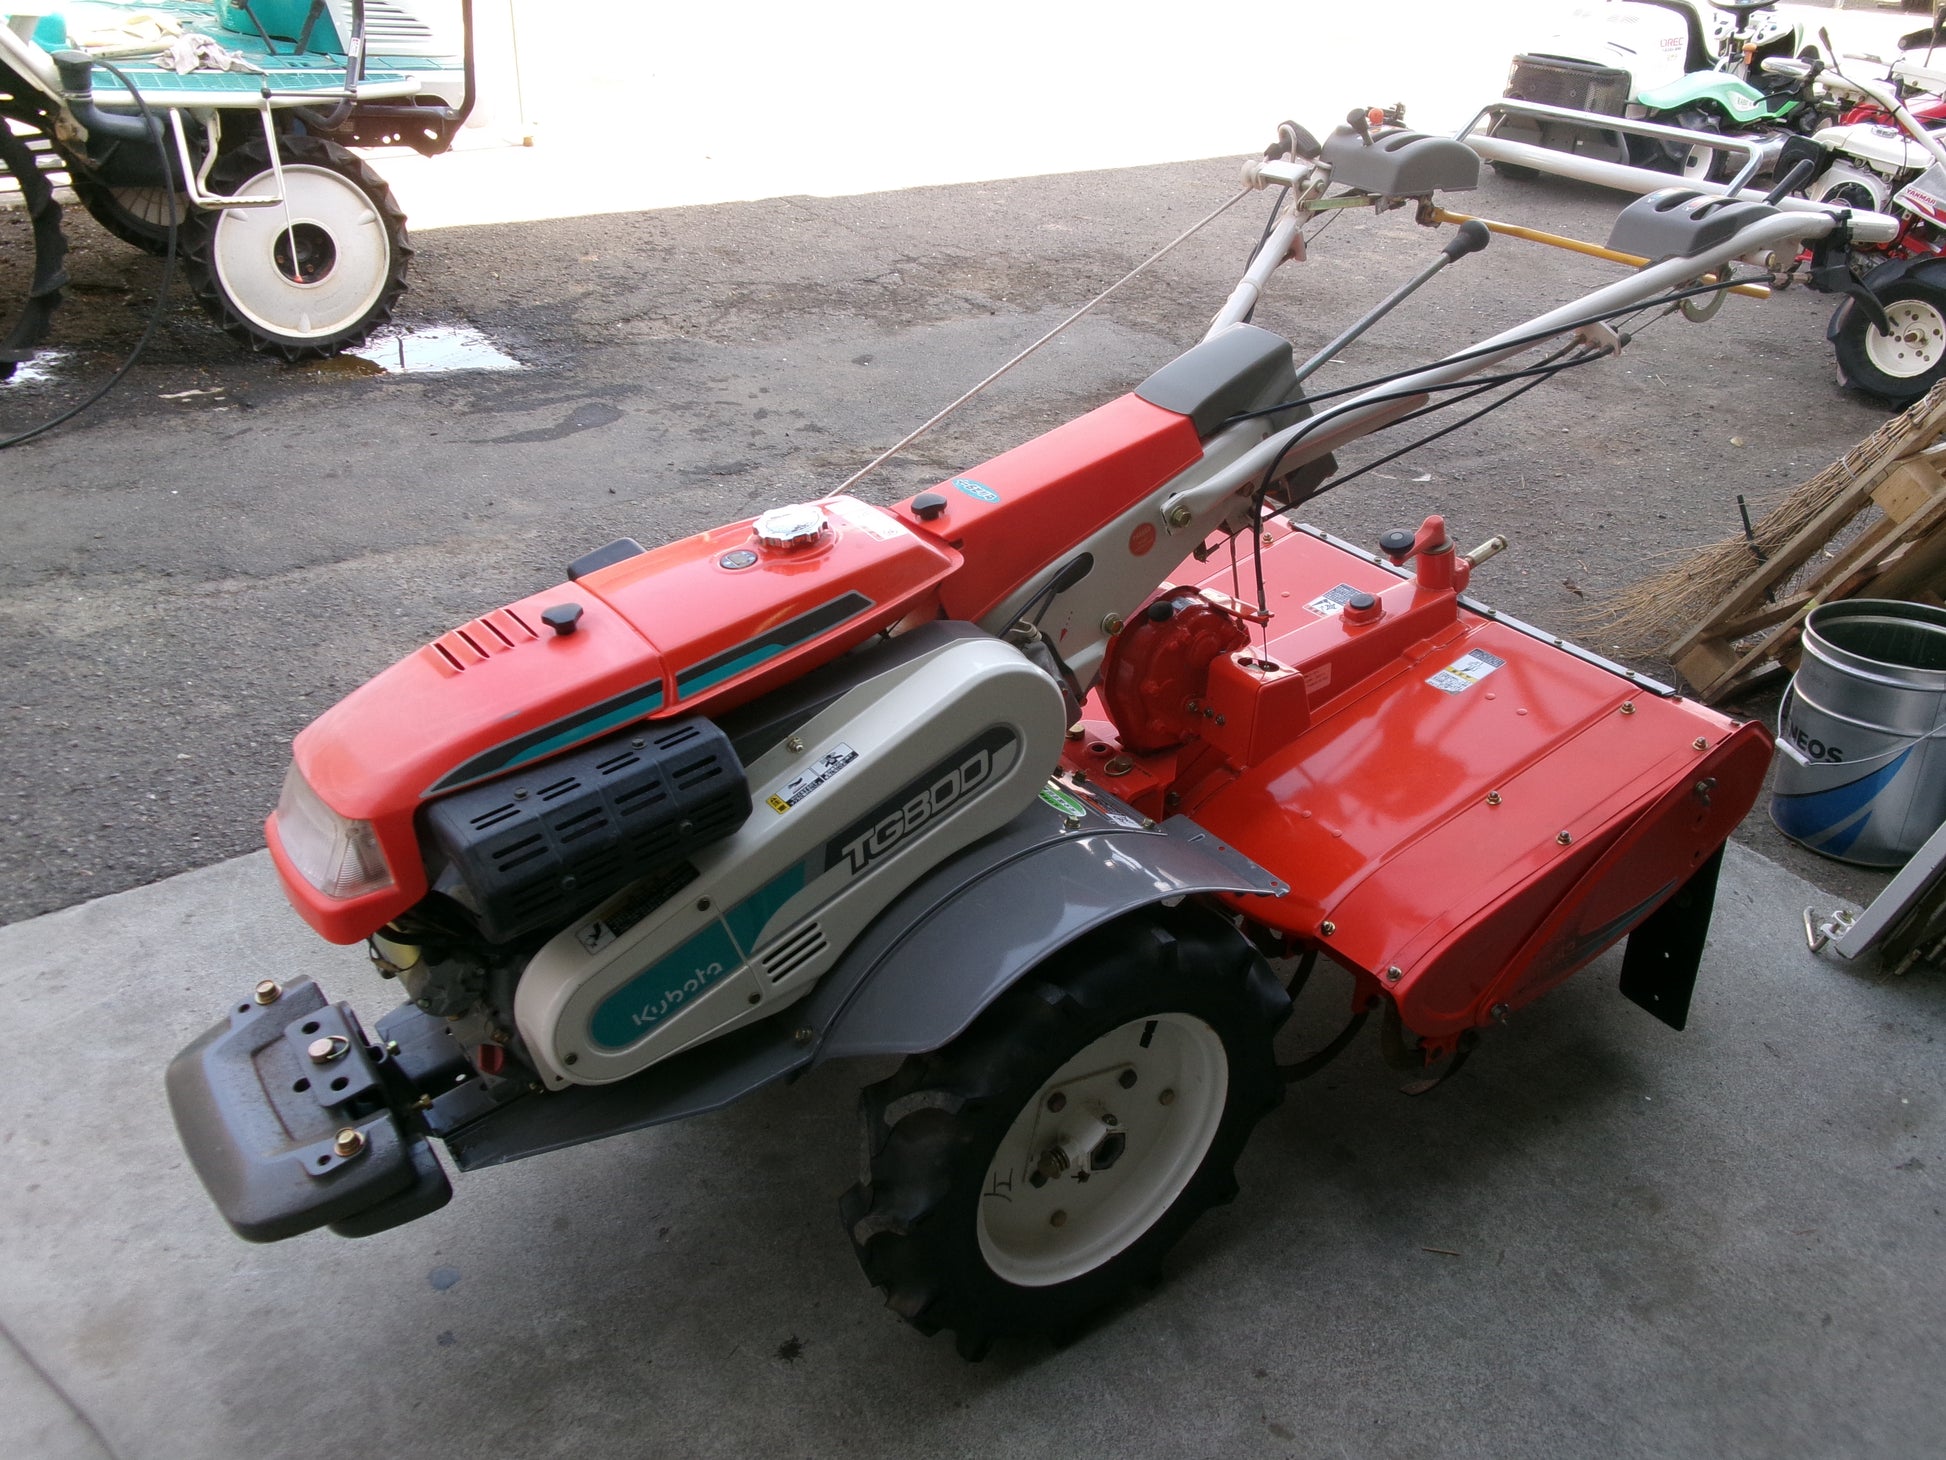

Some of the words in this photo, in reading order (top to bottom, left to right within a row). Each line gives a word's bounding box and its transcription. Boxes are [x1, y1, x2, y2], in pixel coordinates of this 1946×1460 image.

[1906, 188, 1937, 205] YANMAR
[842, 749, 993, 875] TG800
[632, 962, 724, 1026] Kubota
